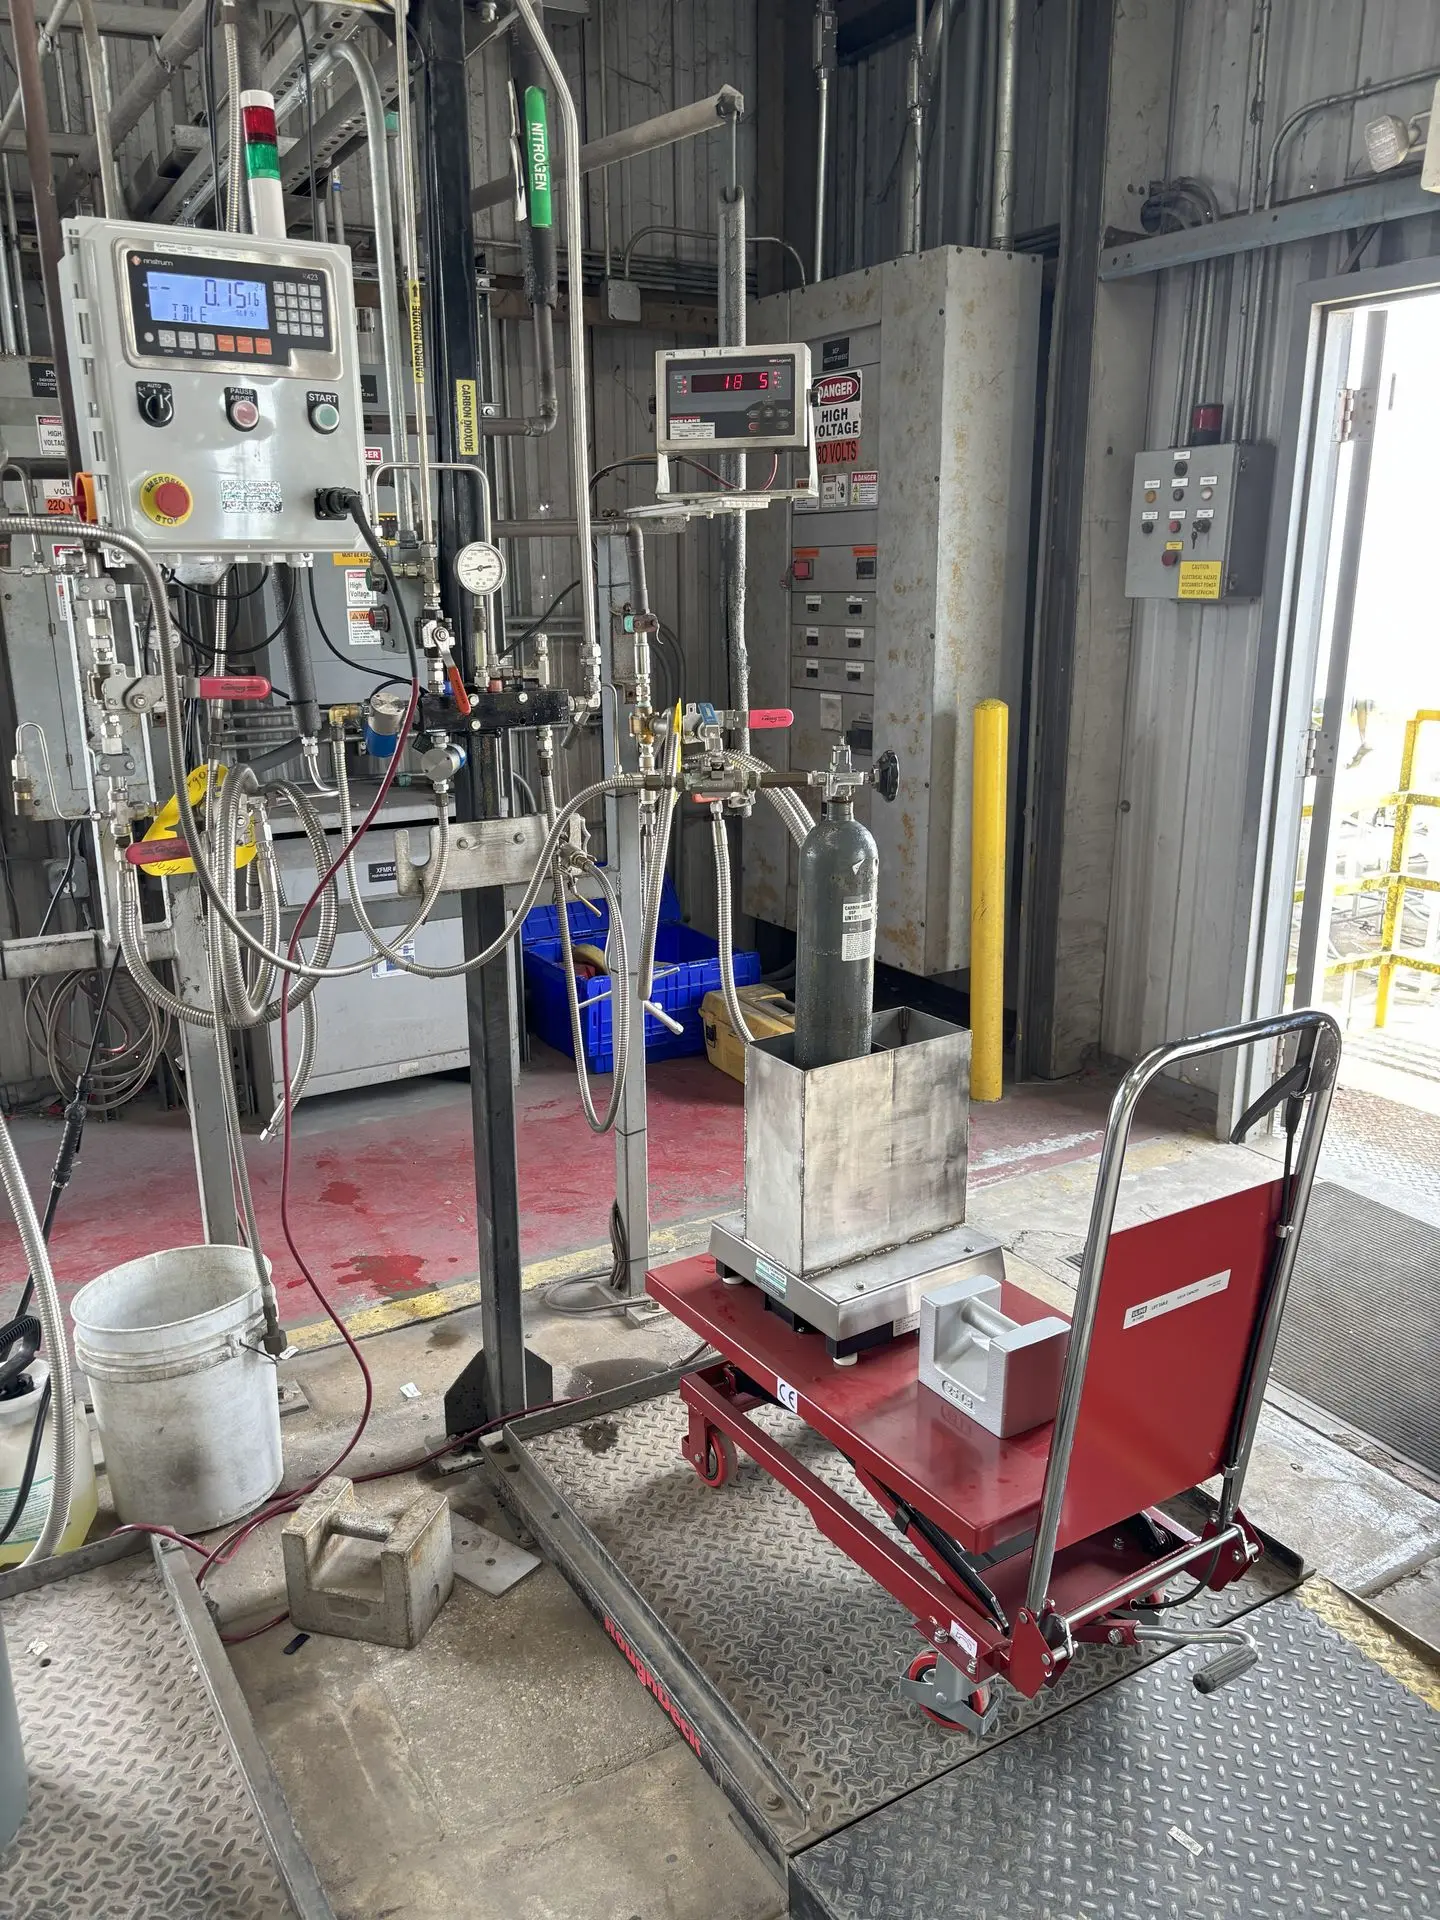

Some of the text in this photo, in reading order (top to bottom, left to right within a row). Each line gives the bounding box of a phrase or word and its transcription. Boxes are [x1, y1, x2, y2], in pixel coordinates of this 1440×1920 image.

[532, 122, 547, 191] NITROGEN
[143, 258, 173, 266] rinstrum
[205, 279, 246, 308] 0.15
[172, 303, 207, 323] IDLE
[411, 305, 424, 379] CARBON DIOXIDE
[229, 387, 254, 395] PAUSE
[308, 393, 337, 403] START
[819, 381, 853, 399] DANGER
[461, 384, 474, 452] CARBON DIOXIDE
[821, 407, 848, 423] HIGH
[44, 439, 65, 447] VOLTAG
[816, 440, 857, 464] 80 VOLTS
[857, 474, 876, 482] DANGER
[47, 499, 65, 511] 220
[155, 514, 178, 525] STOP
[350, 581, 362, 590] High
[779, 1384, 795, 1408] CE
